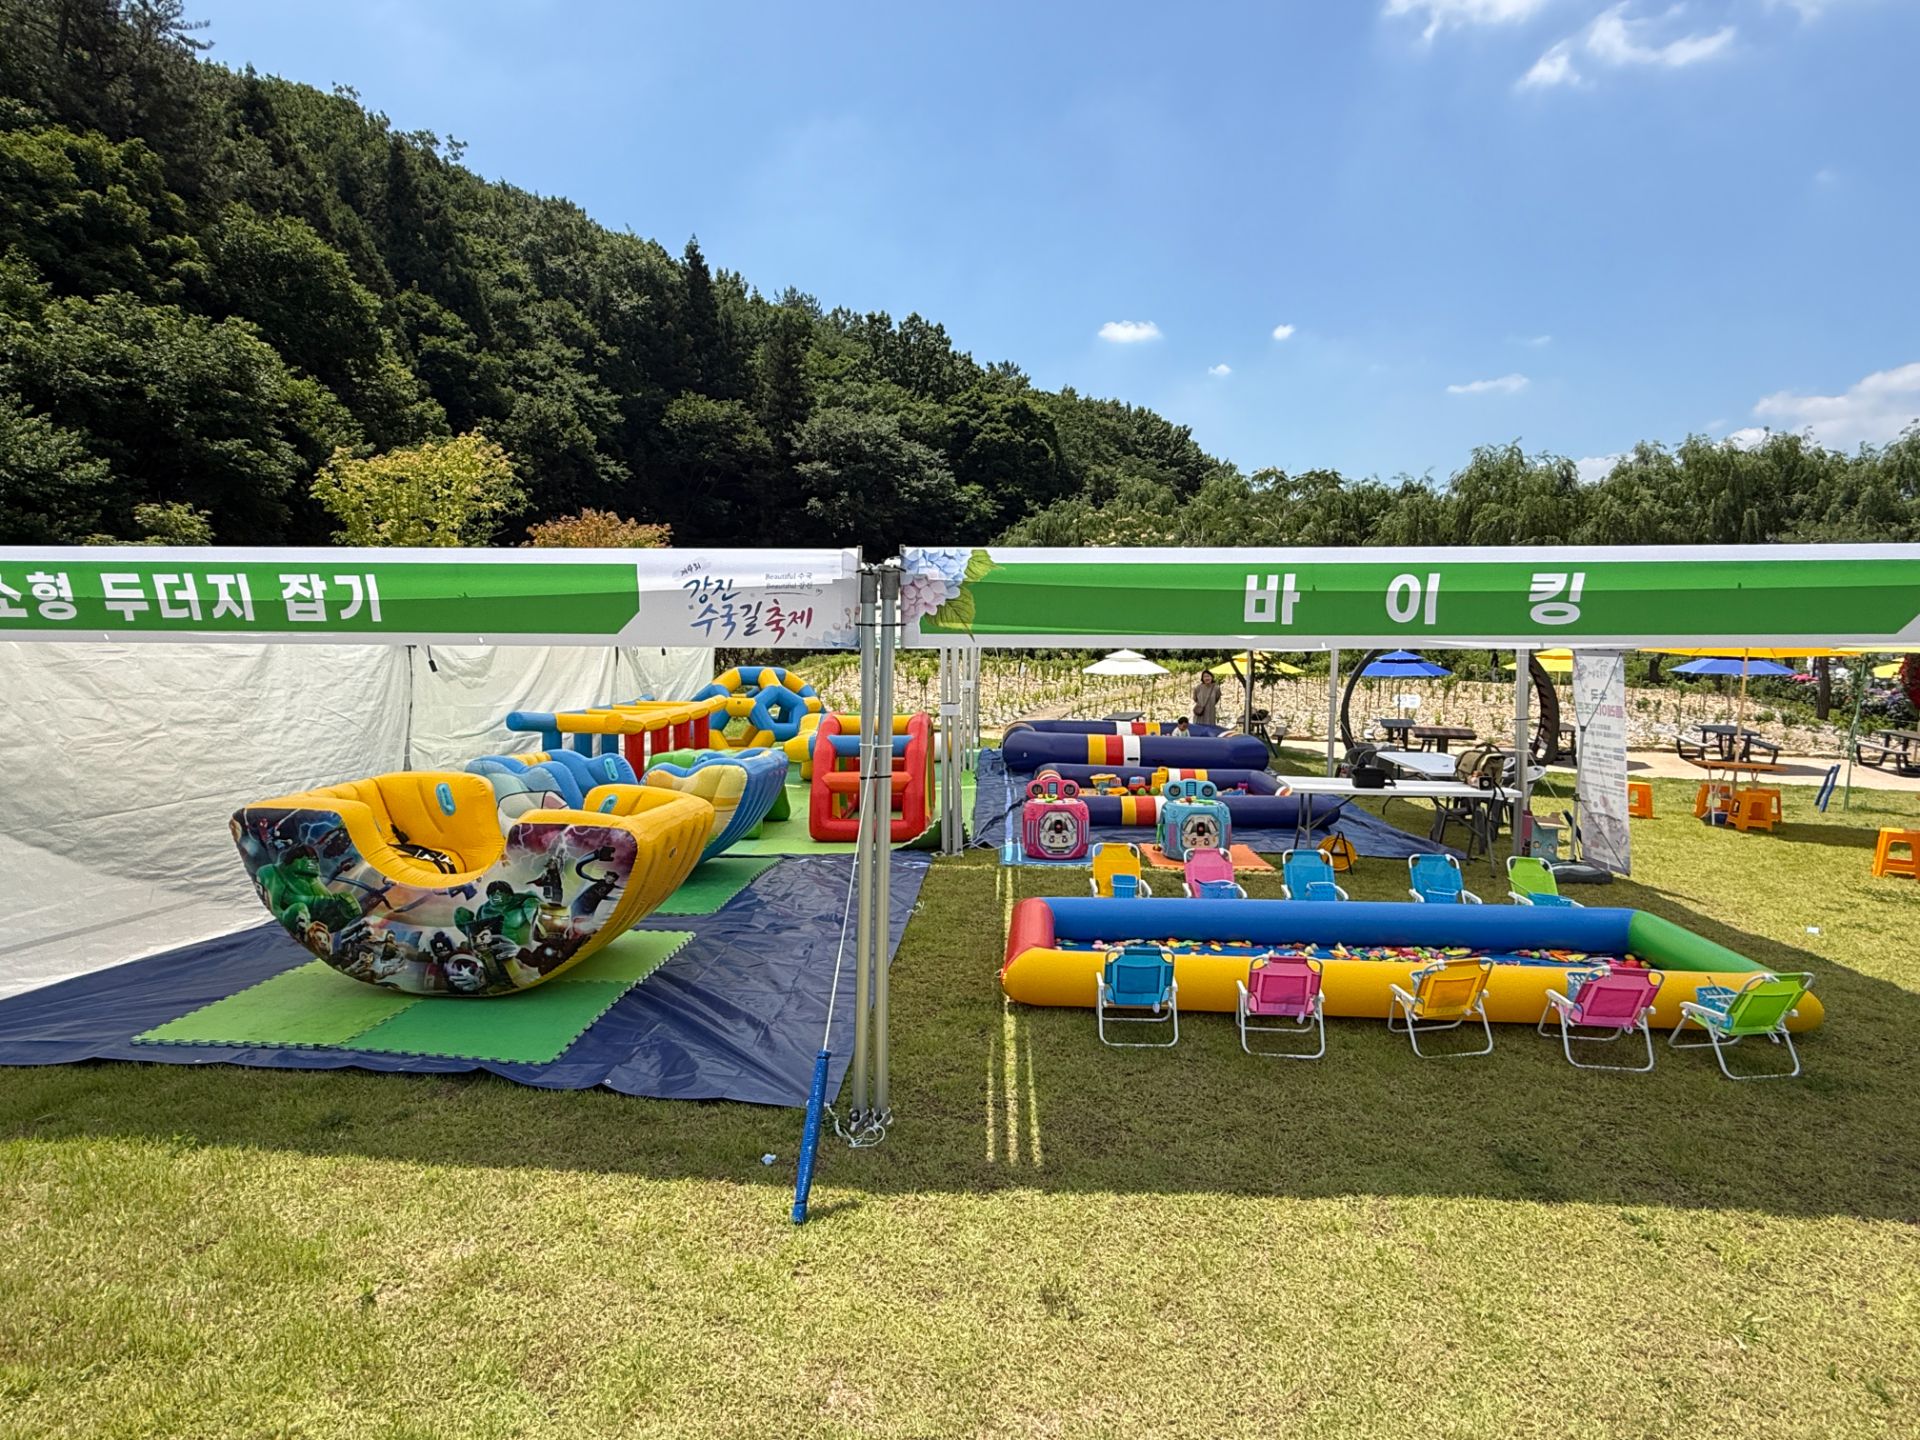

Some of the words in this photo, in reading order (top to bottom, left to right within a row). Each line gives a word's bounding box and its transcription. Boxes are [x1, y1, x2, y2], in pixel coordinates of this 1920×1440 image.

[99, 573, 255, 622] 두더지
[278, 573, 382, 622] 잡기
[683, 575, 741, 604] 강진
